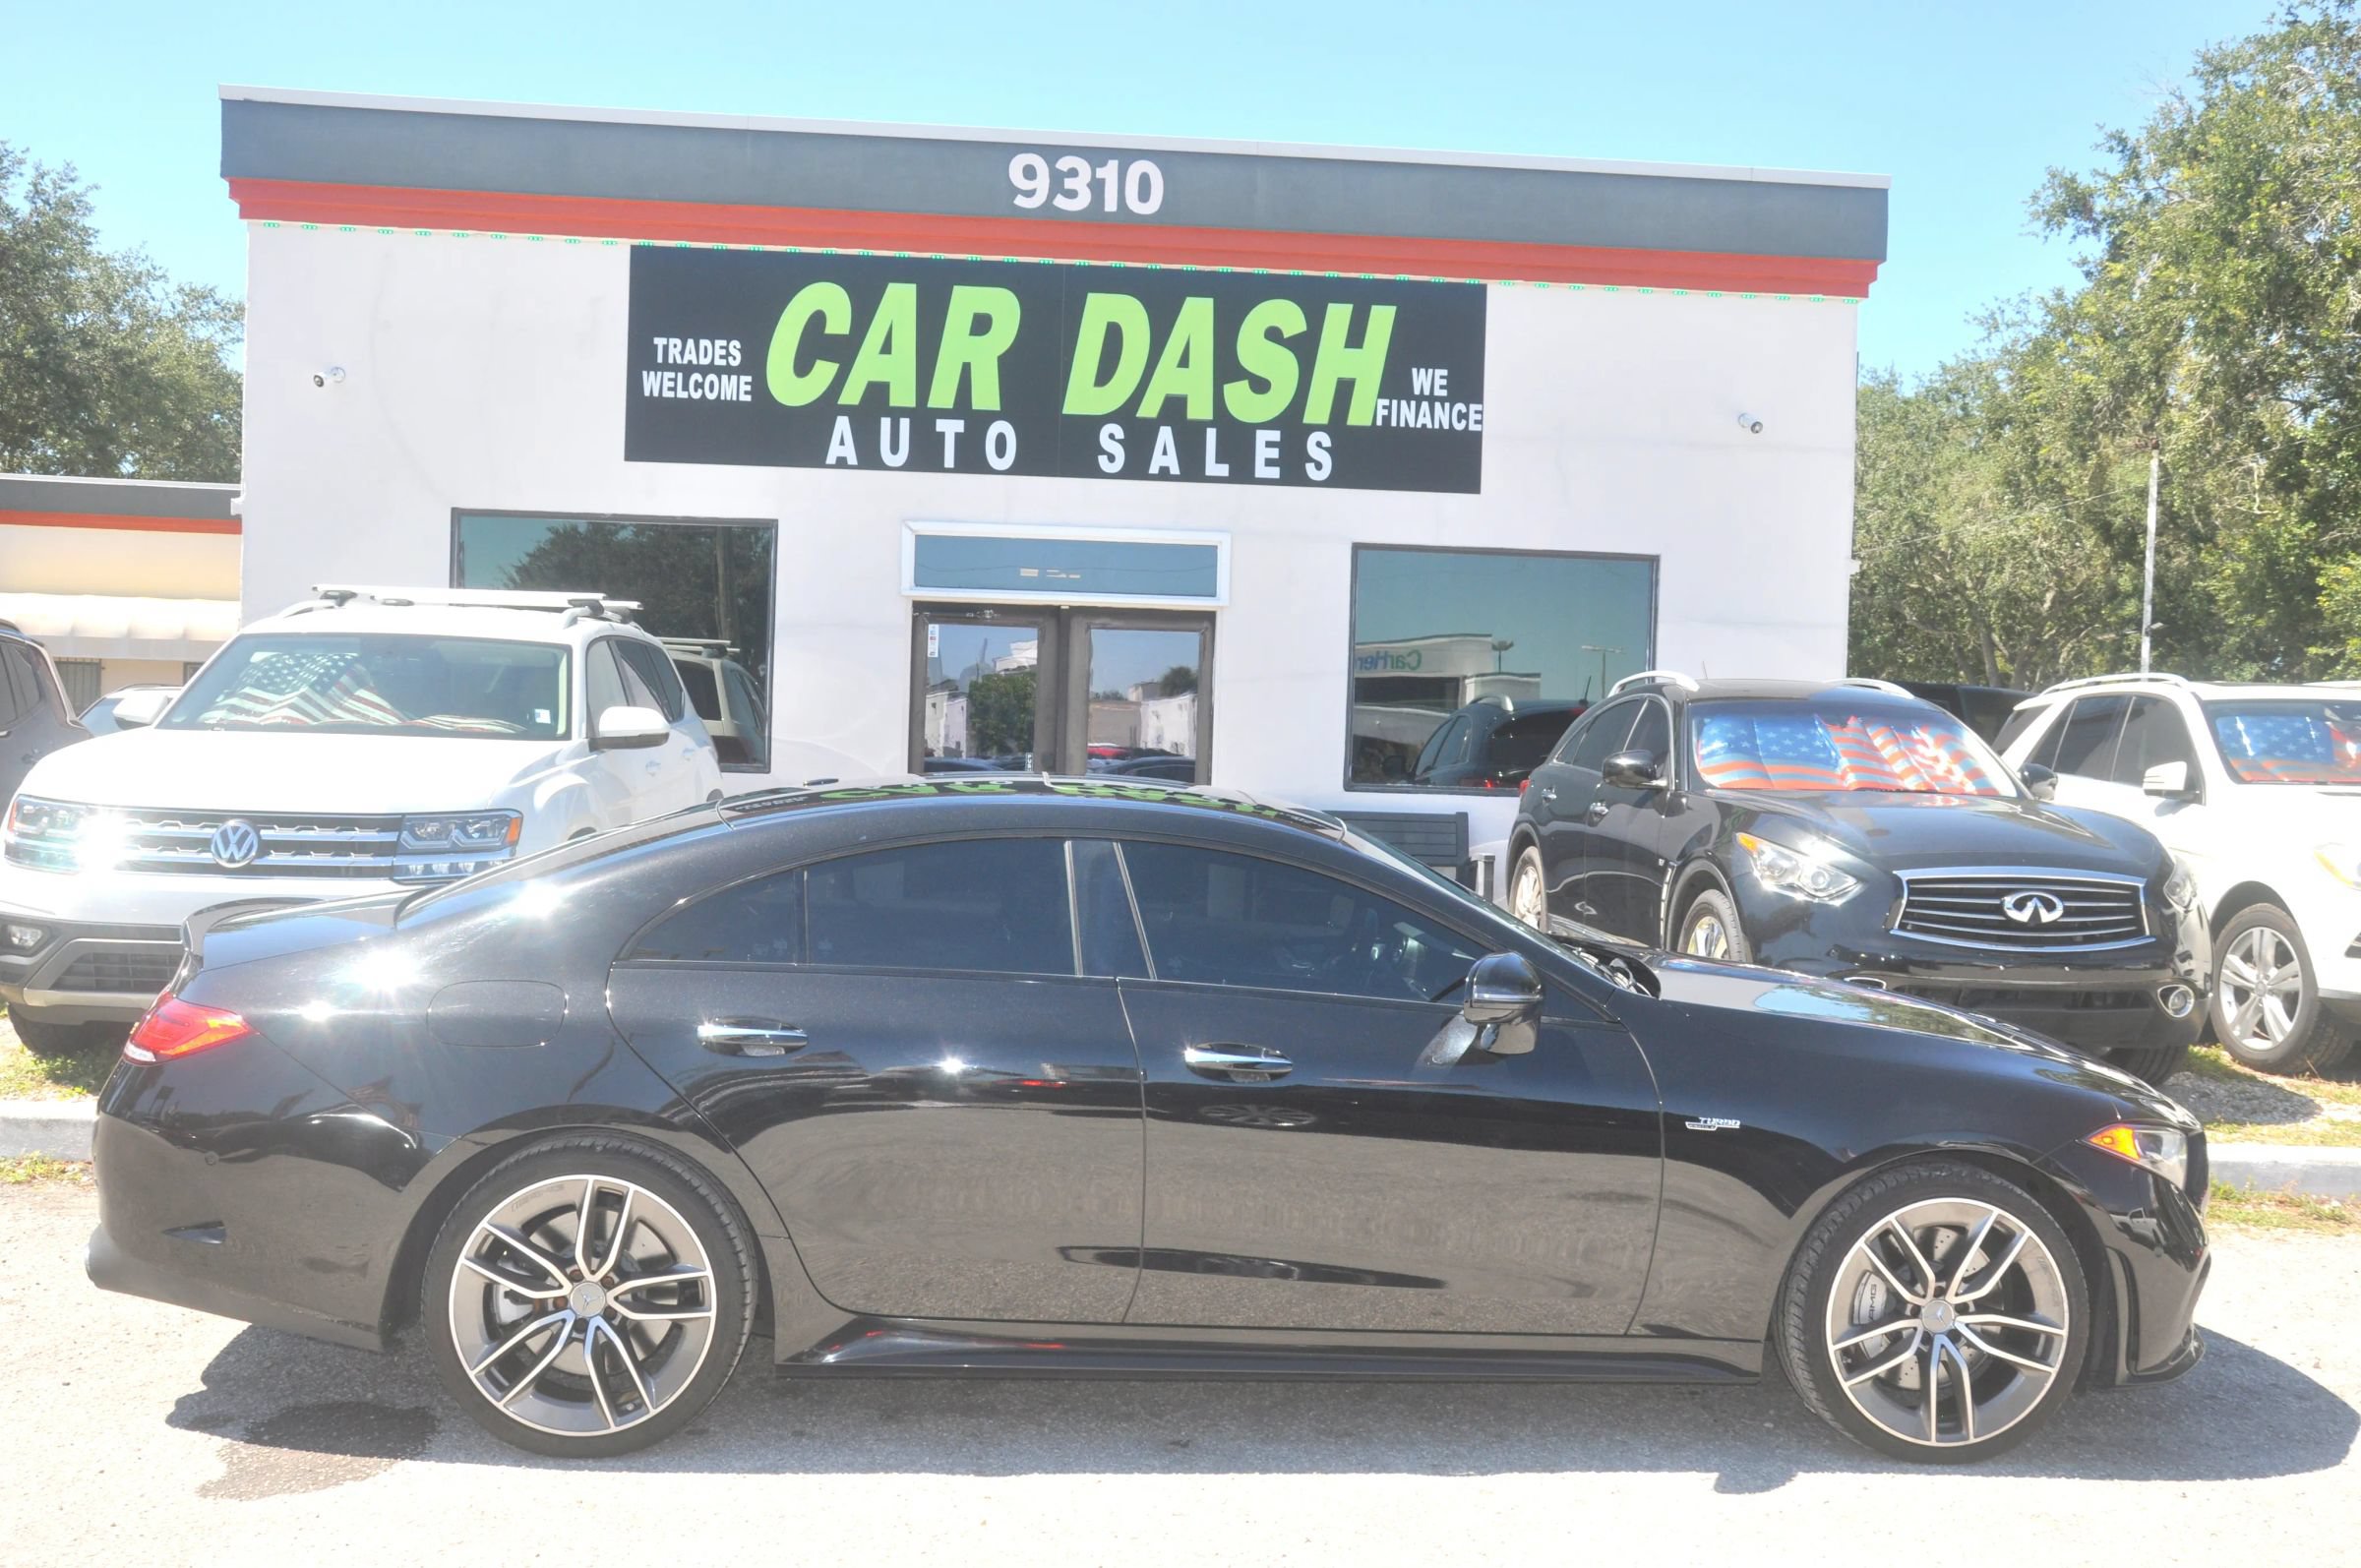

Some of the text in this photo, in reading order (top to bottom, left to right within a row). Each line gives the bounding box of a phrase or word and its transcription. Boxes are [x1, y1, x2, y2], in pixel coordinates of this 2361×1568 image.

[1008, 152, 1165, 215] 9310
[653, 336, 742, 367] TRADES
[765, 281, 1398, 427] CAR DASH
[641, 370, 753, 402] WELCOME
[1411, 367, 1448, 396] WE
[1375, 397, 1483, 432] FINANCE
[824, 415, 1333, 482] AUTO SALES
